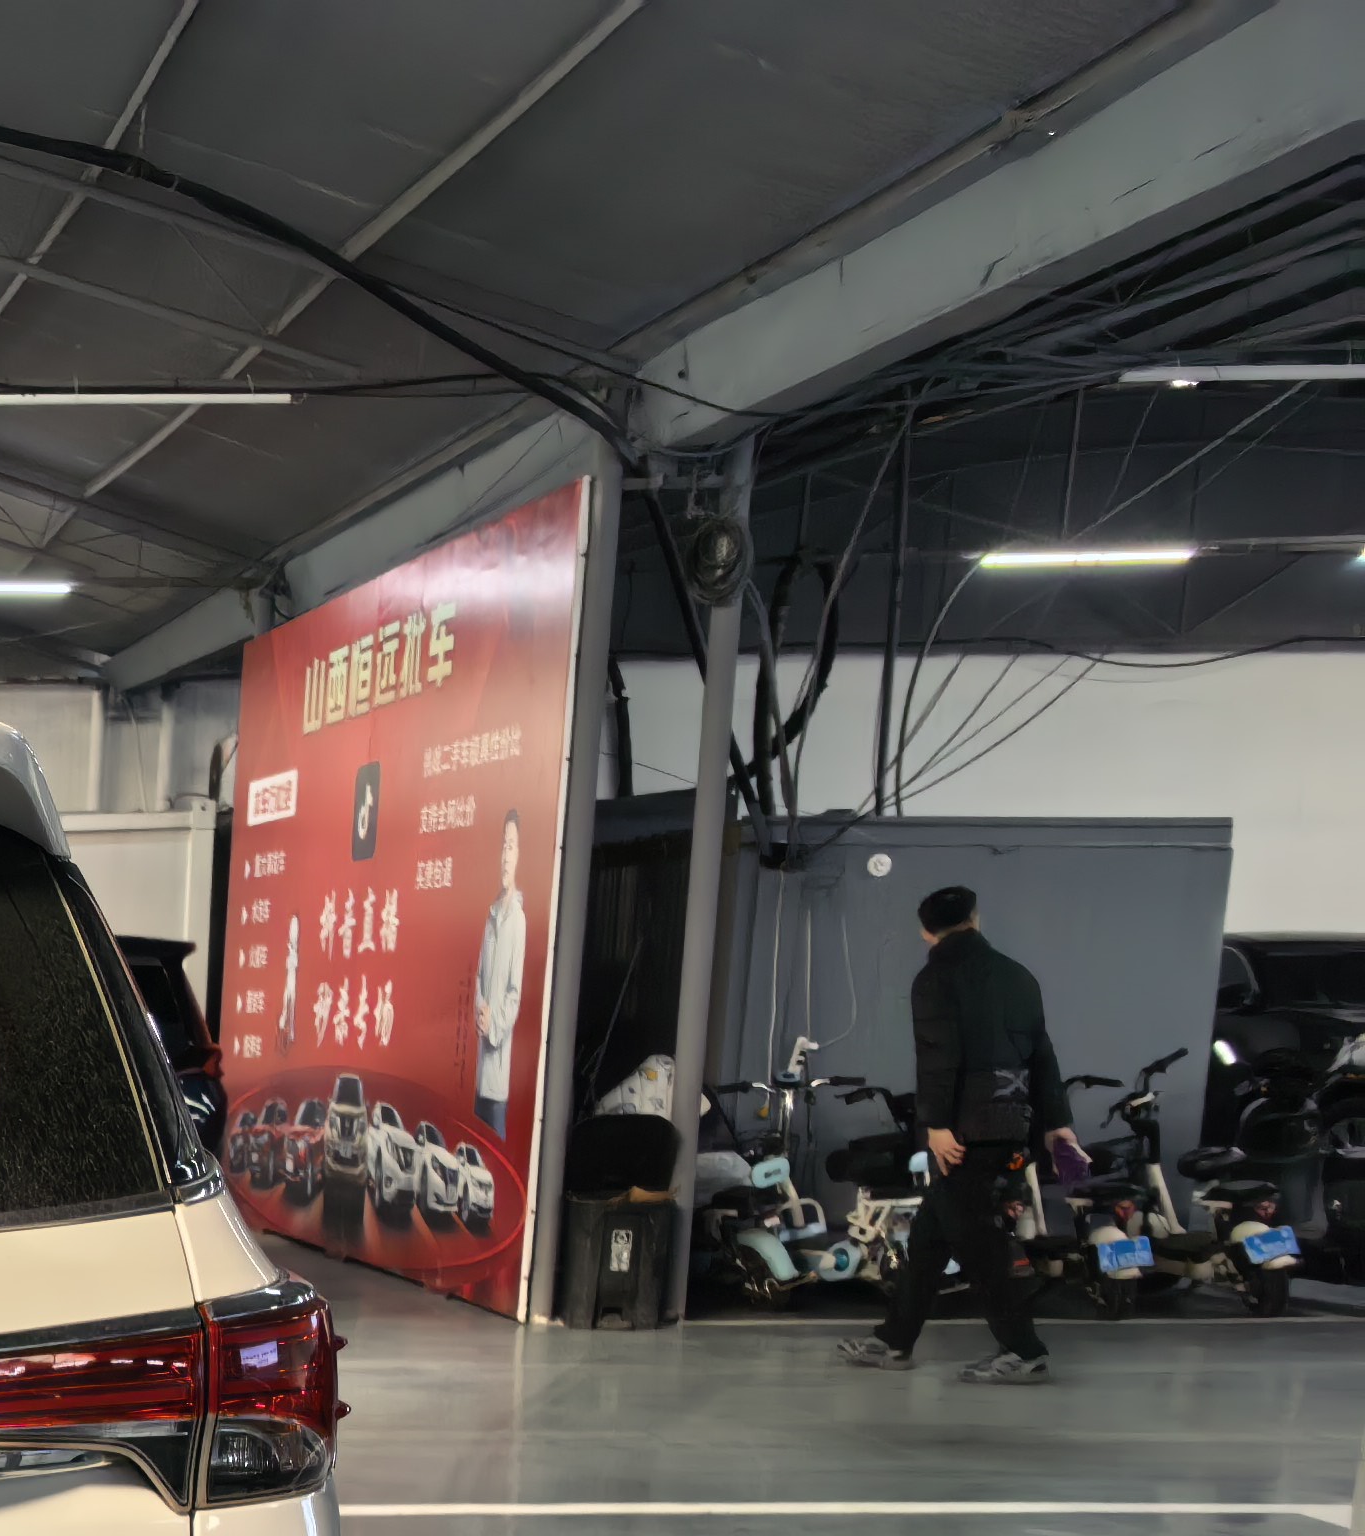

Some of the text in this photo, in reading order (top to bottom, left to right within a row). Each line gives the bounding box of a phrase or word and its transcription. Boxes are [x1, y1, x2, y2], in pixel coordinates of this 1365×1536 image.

[303, 602, 456, 735] 山西恒远批车
[319, 886, 400, 961] 抖音直播
